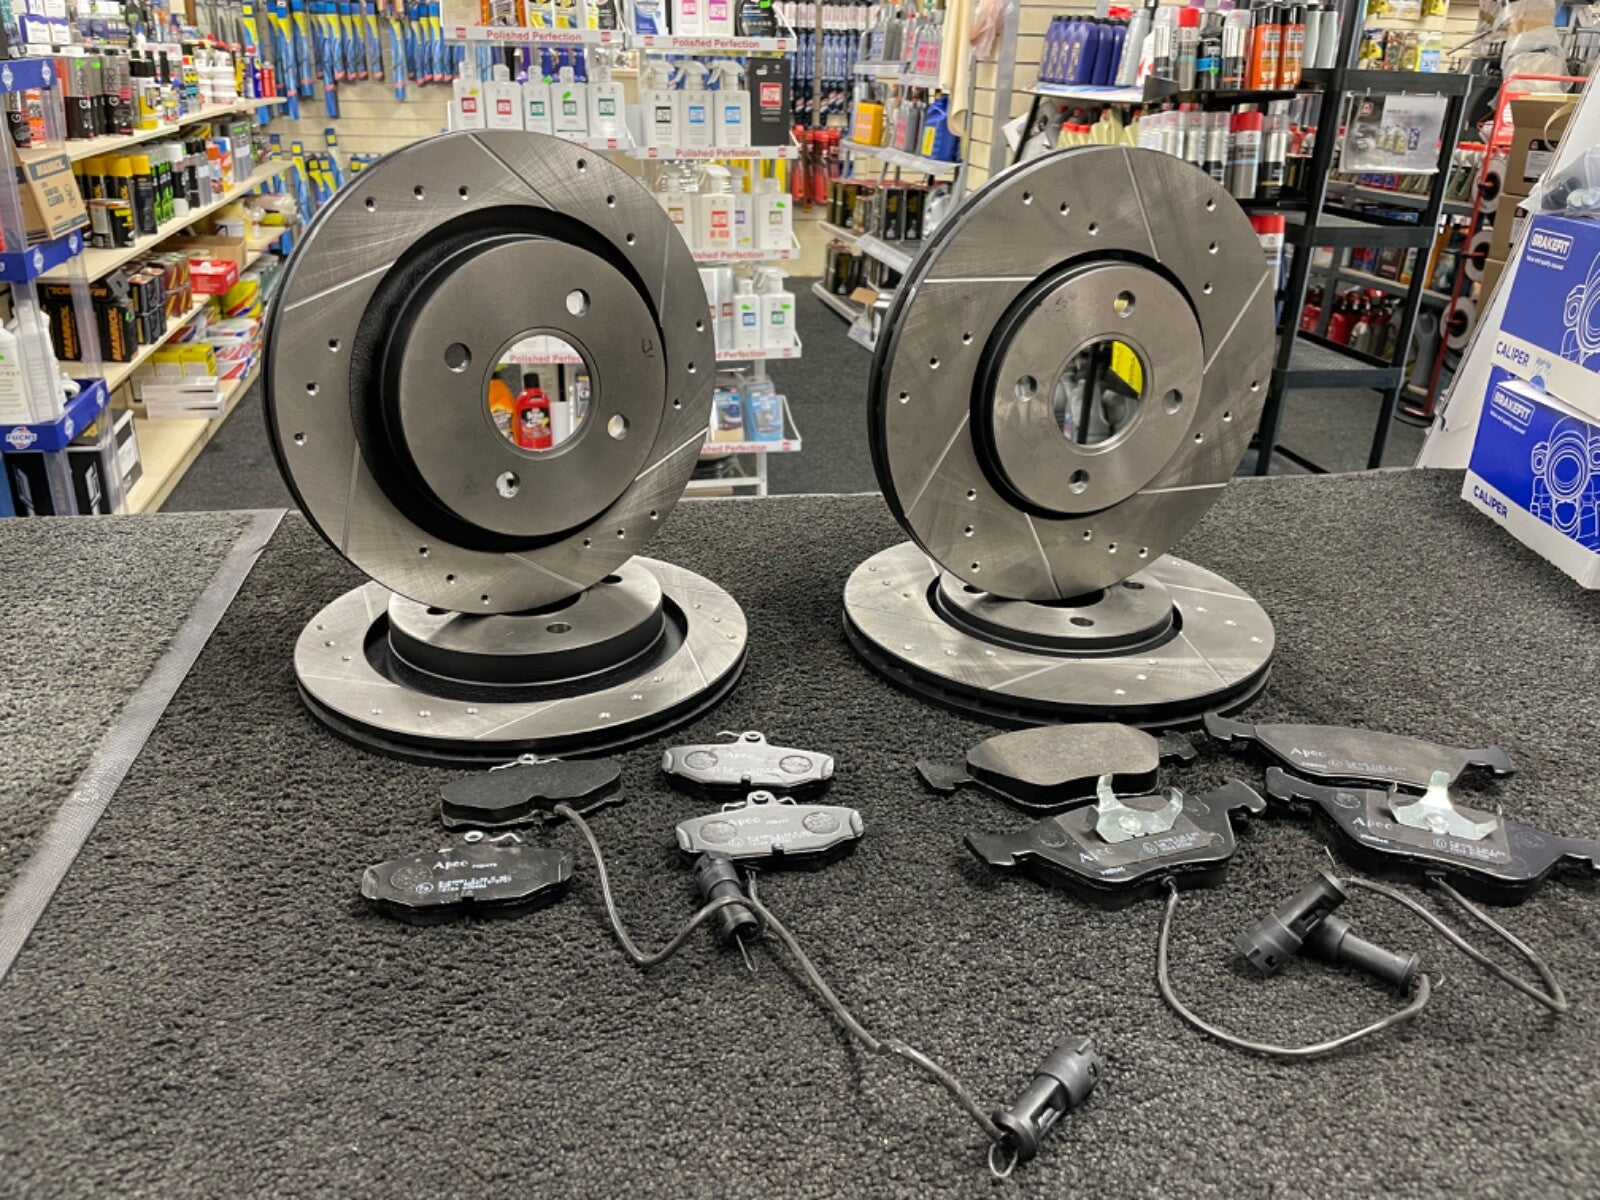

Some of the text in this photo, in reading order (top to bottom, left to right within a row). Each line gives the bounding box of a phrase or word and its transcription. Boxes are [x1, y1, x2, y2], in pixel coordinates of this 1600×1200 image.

[486, 30, 581, 41] Polished Perfection
[672, 38, 759, 48] Polished Perfection
[676, 149, 761, 158] Polished Perfection
[1531, 233, 1571, 254] BRAKEFIT
[509, 355, 549, 363] Polished
[1496, 341, 1530, 367] CALIPER
[7, 433, 36, 441] FUCHS
[1473, 485, 1508, 519] CALIPER
[1290, 747, 1327, 758] Apec
[1352, 817, 1393, 830] Apec
[433, 860, 469, 870] Apec
